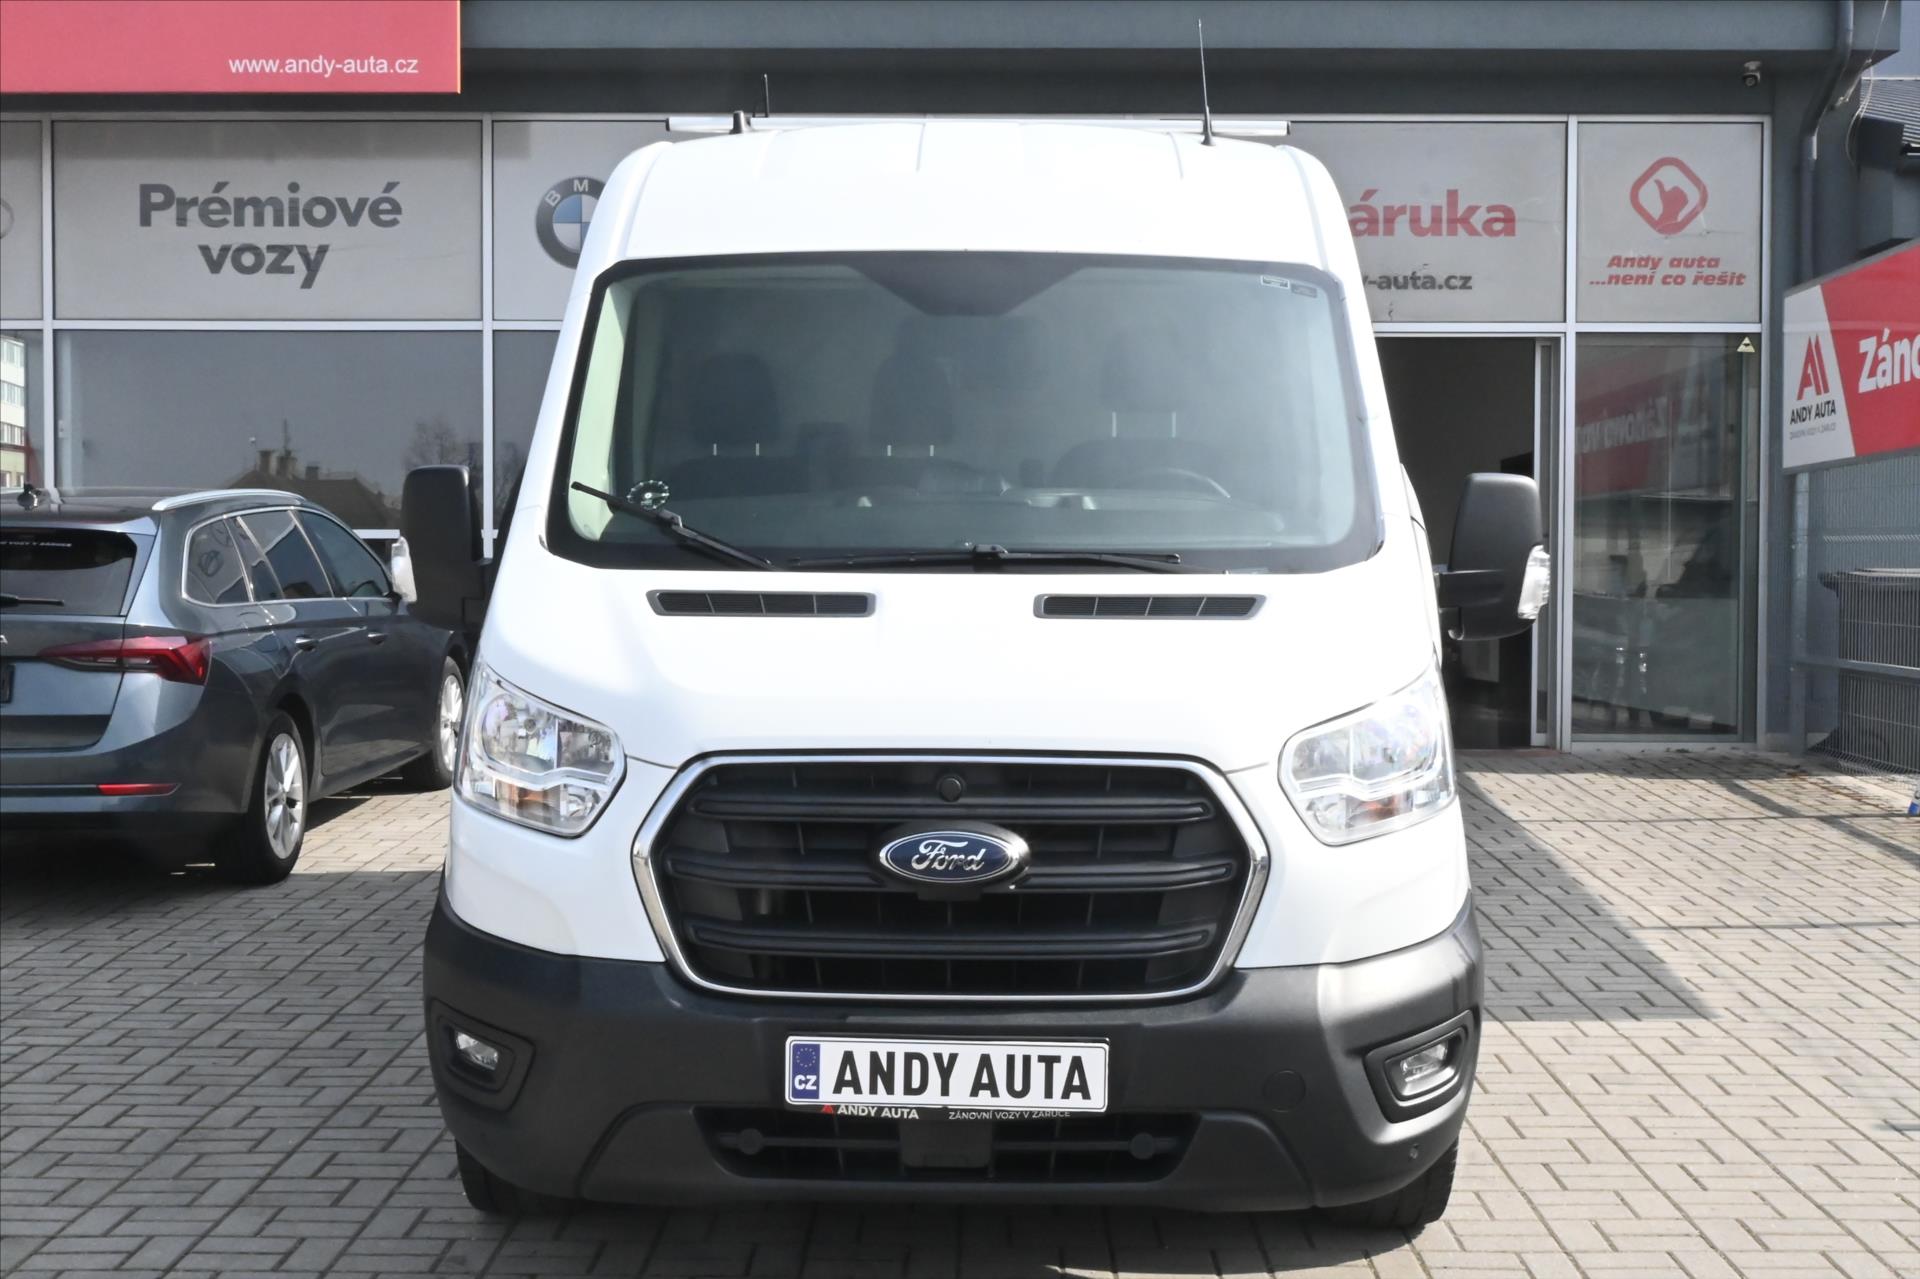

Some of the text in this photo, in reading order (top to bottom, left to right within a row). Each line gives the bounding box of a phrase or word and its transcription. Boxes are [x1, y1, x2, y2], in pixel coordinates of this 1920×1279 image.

[228, 54, 419, 78] www.andy-auta.cz
[138, 181, 403, 228] Prémiové
[197, 243, 330, 290] vozy
[1606, 255, 1721, 270] Andy auta
[1661, 273, 1686, 286] co
[1692, 270, 1746, 286] řešit
[1789, 399, 1837, 426] ANDY AUTA
[911, 839, 986, 871] Ford
[793, 1074, 818, 1091] CZ
[832, 1050, 1092, 1101] ANDY AUTA
[837, 1104, 920, 1120] ANDY AUTA
[948, 1110, 994, 1120] ZÁNOVNÍ
[994, 1110, 1021, 1119] VOZY
[1022, 1111, 1031, 1119] V
